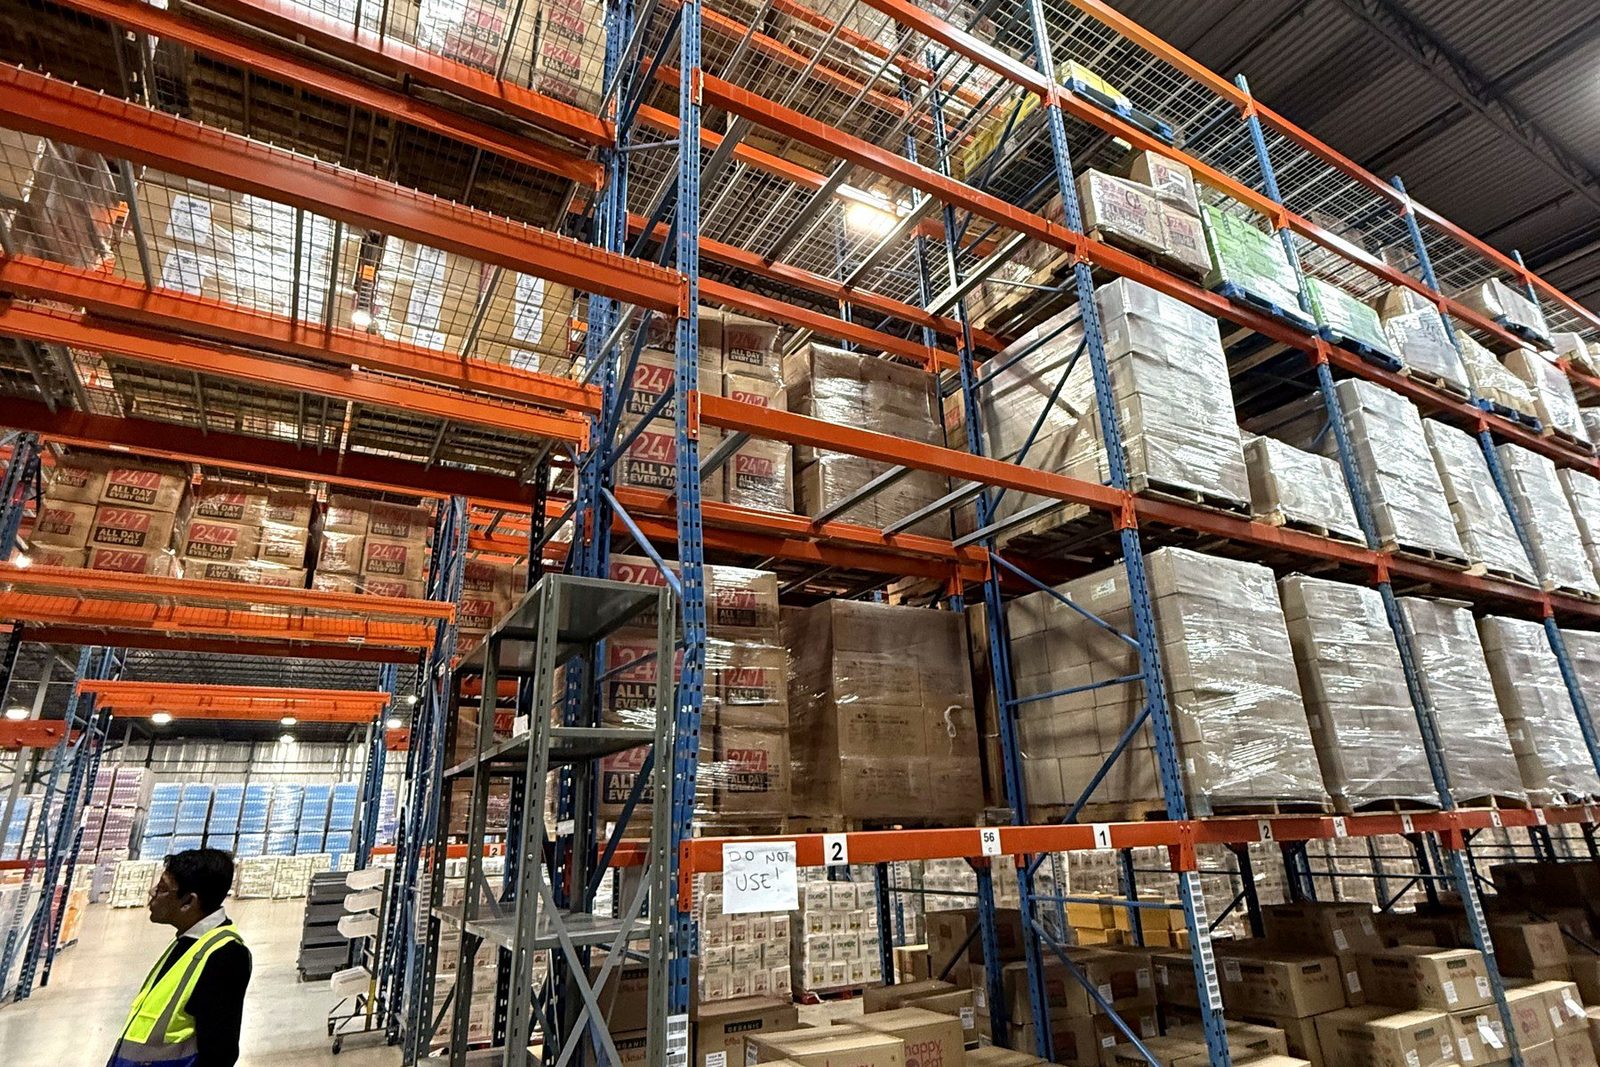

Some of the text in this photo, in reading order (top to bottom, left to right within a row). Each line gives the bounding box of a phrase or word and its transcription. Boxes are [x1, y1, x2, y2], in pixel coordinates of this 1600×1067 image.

[731, 348, 746, 356] ALL
[633, 364, 673, 391] 24/
[631, 391, 656, 405] ALL
[633, 432, 676, 460] 24/
[630, 462, 676, 477] ALL DA
[630, 474, 664, 484] EVERY
[110, 484, 152, 497] ALL DAY
[221, 504, 240, 512] DAY
[104, 510, 147, 530] 24/7
[98, 527, 141, 540] ALL DAY
[194, 524, 234, 543] 24/7
[190, 543, 229, 553] ALL DAY
[372, 544, 403, 560] 24/7
[100, 551, 143, 571] 24/7
[619, 648, 657, 680] 24/
[615, 684, 643, 698] ALL
[495, 713, 513, 730] 4/7
[731, 774, 764, 783] ALL DAY
[983, 831, 995, 843] 56
[1099, 830, 1107, 846] 1
[1263, 825, 1271, 839] 2
[491, 847, 498, 856] 2
[728, 850, 790, 864] DO NOT
[832, 842, 843, 861] 2
[735, 867, 780, 892] USE!
[904, 1039, 943, 1061] happy
